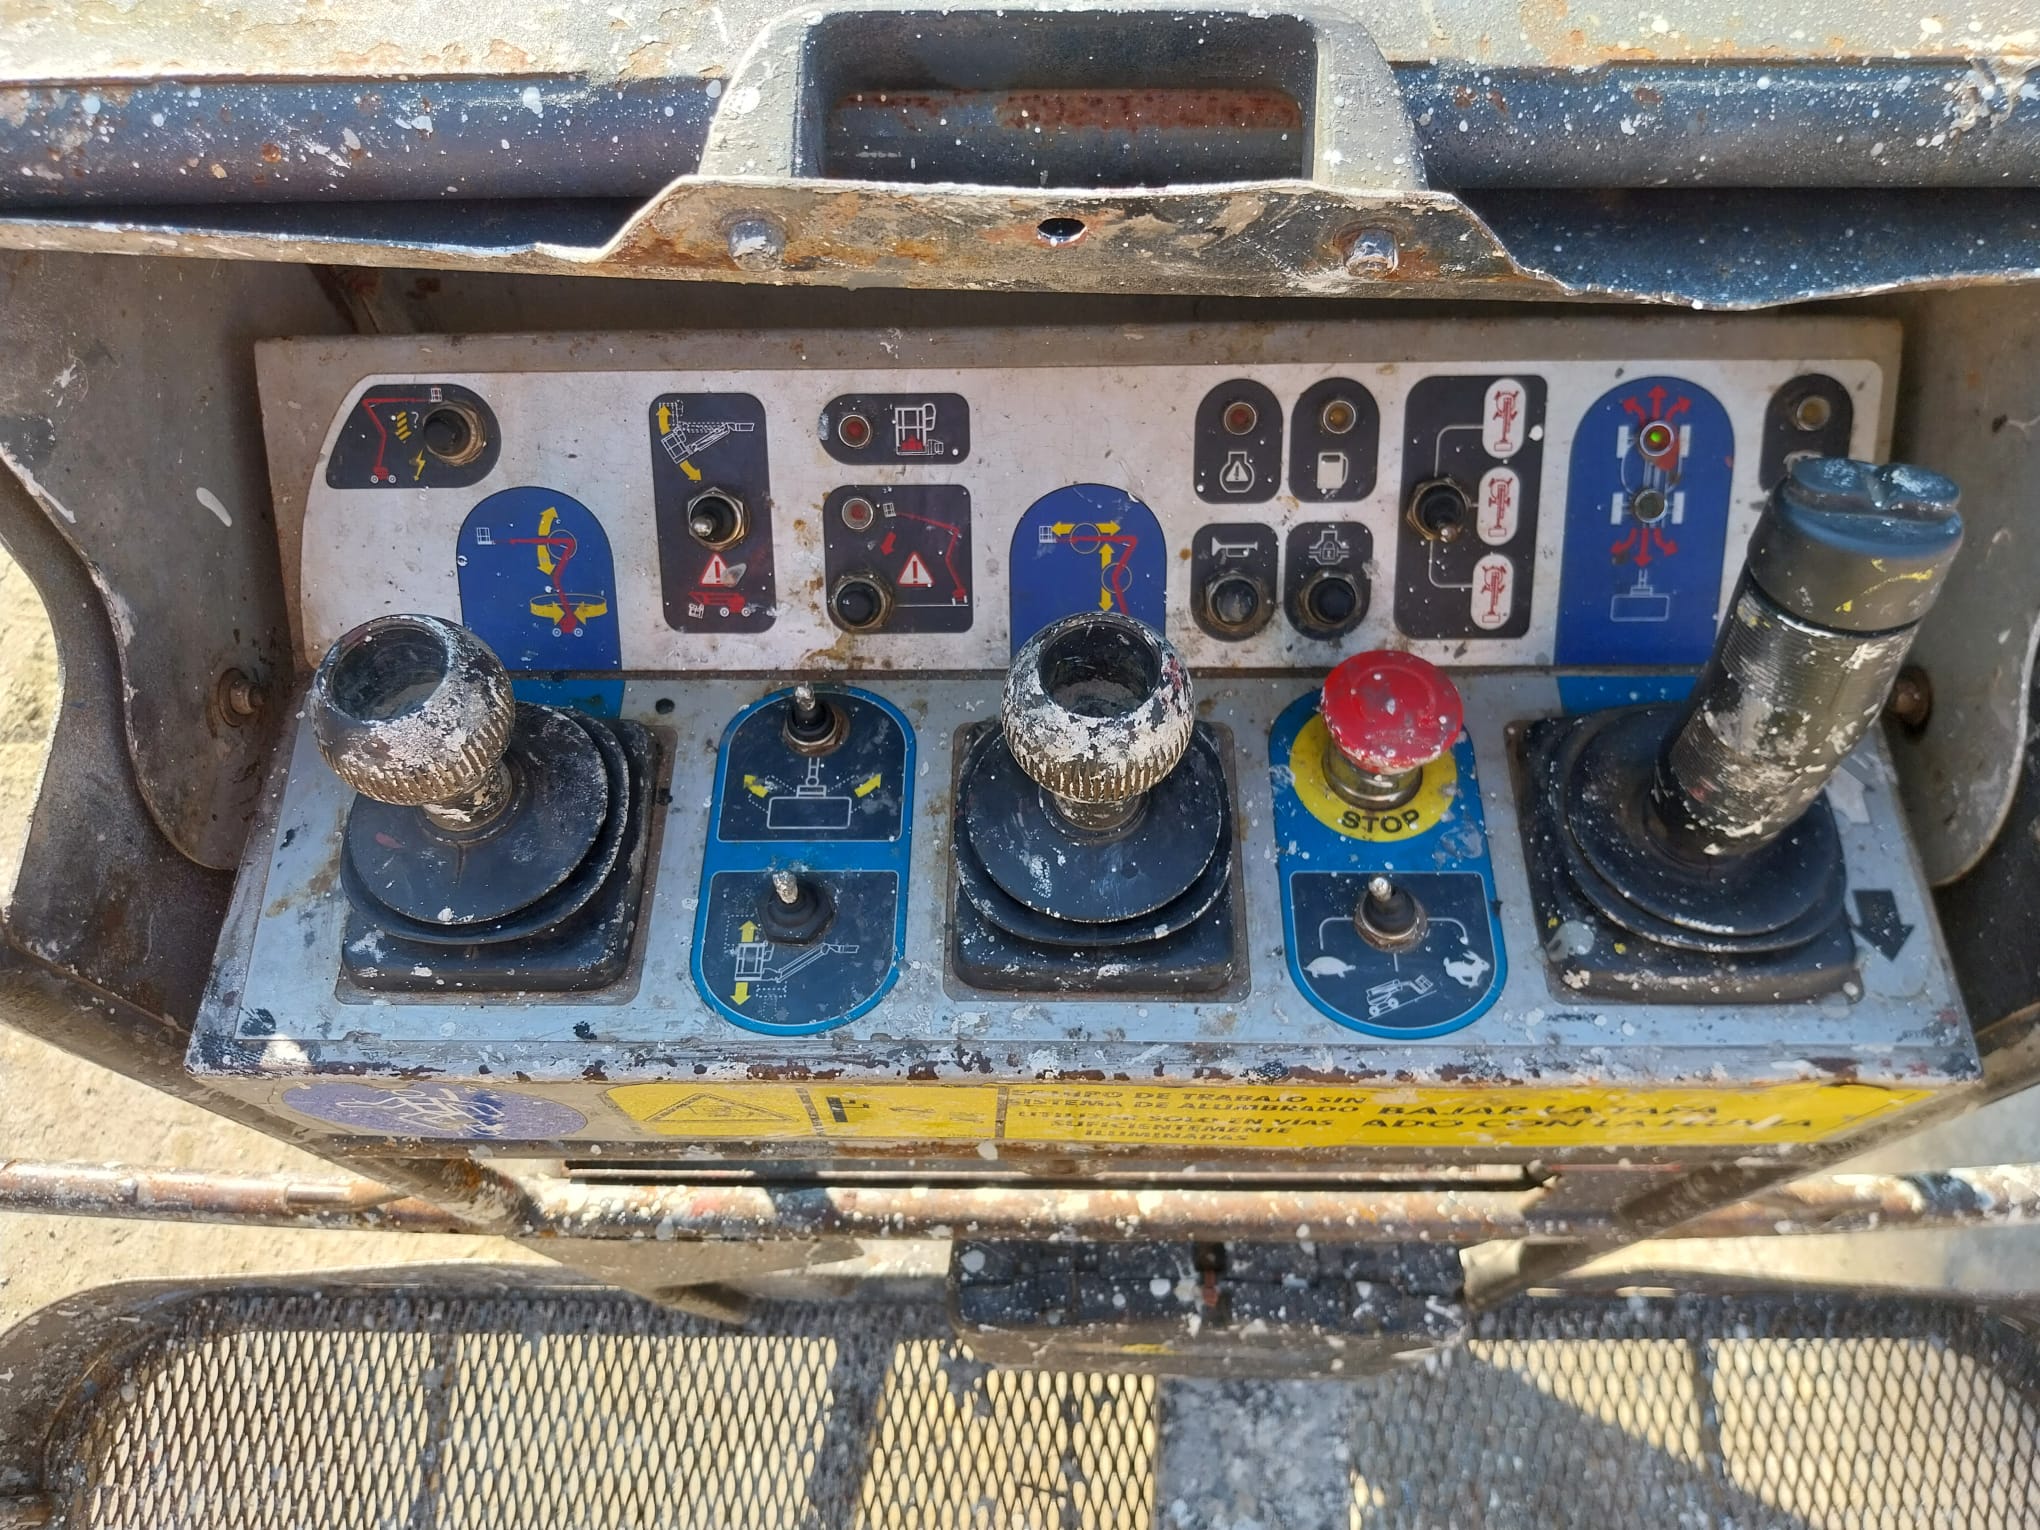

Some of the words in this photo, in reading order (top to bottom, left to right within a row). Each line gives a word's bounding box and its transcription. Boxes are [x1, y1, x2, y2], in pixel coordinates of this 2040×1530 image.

[1342, 809, 1420, 834] STOP
[1134, 1092, 1172, 1100] DE
[1181, 1093, 1308, 1103] TRABAJO
[1316, 1096, 1368, 1104] SIN
[1008, 1098, 1123, 1108] SISTEMA
[1134, 1101, 1169, 1109] DE
[1177, 1102, 1360, 1113] ALUMBRADO
[1378, 1104, 1529, 1115] BAJAR
[1228, 1117, 1265, 1125] EN
[1477, 1118, 1585, 1128] CON
